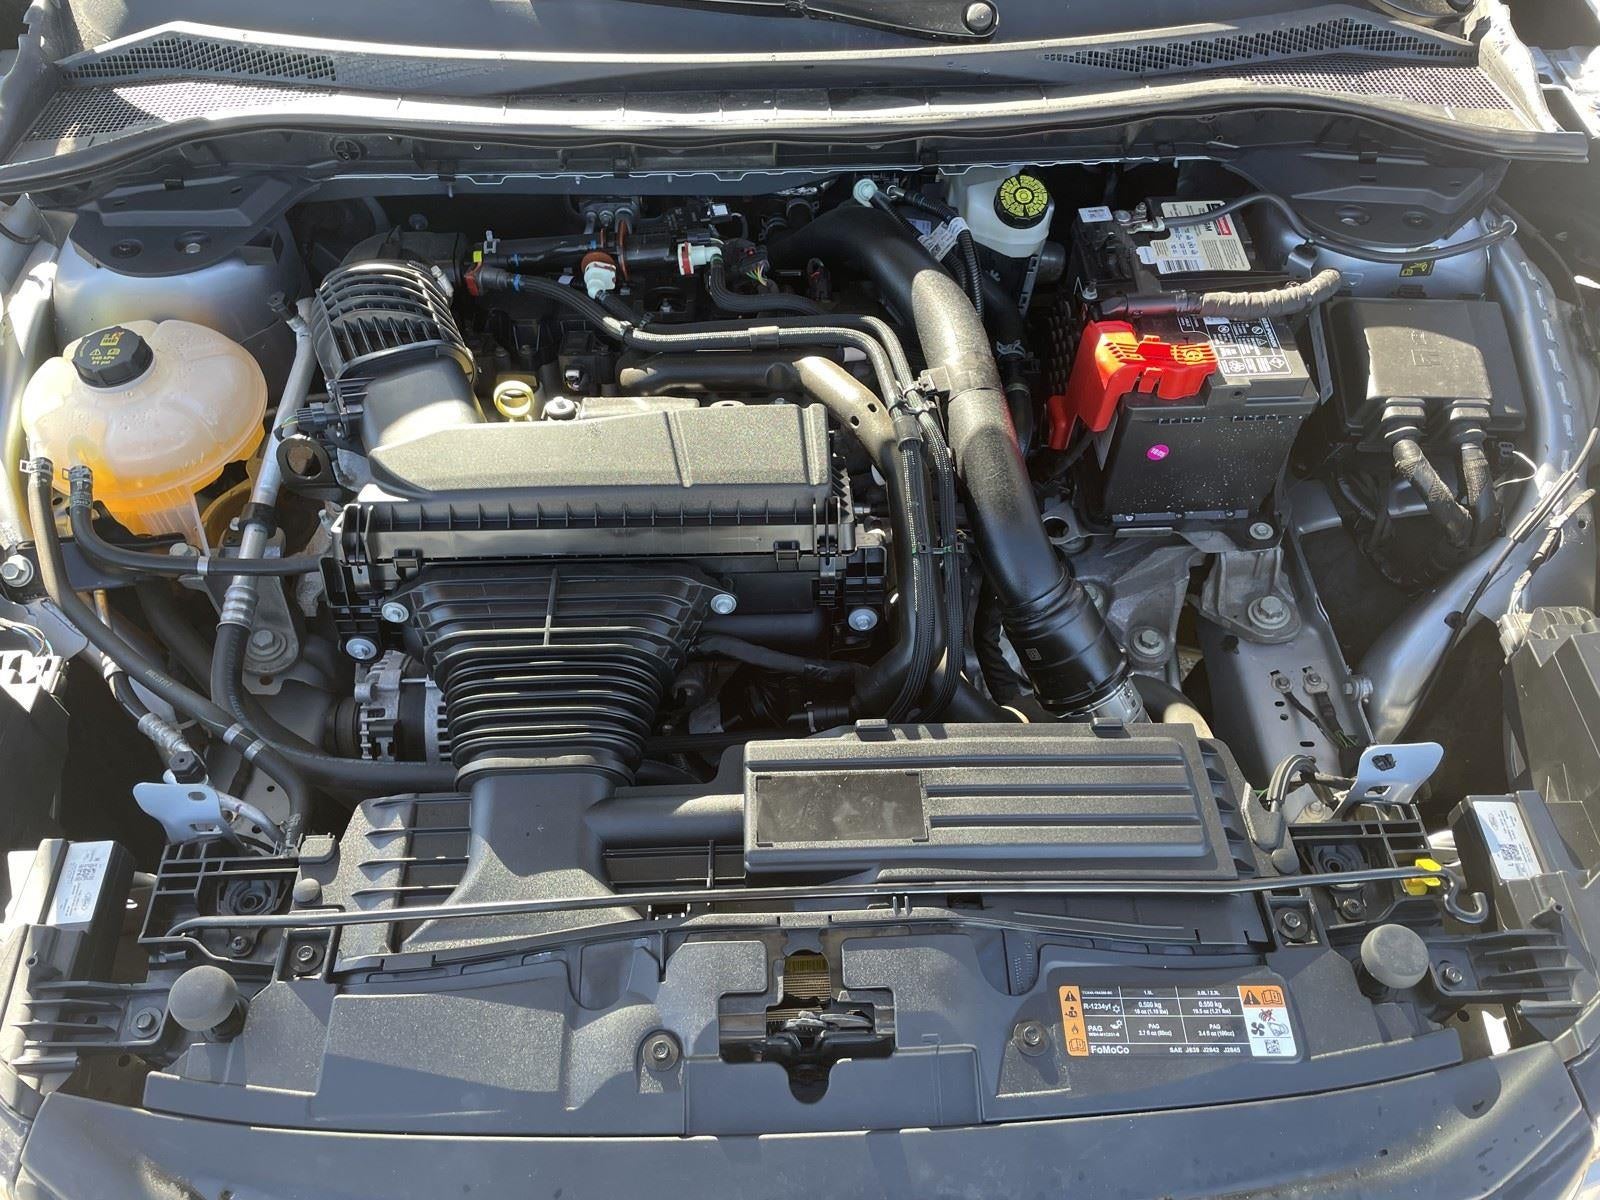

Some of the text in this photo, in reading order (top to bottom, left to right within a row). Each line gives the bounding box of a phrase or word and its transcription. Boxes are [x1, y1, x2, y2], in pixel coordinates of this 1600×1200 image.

[1083, 1003, 1112, 1011] R-1234yf
[1154, 1001, 1162, 1009] kg
[1214, 1001, 1223, 1009] kg
[1091, 1045, 1130, 1054] FoMoCo
